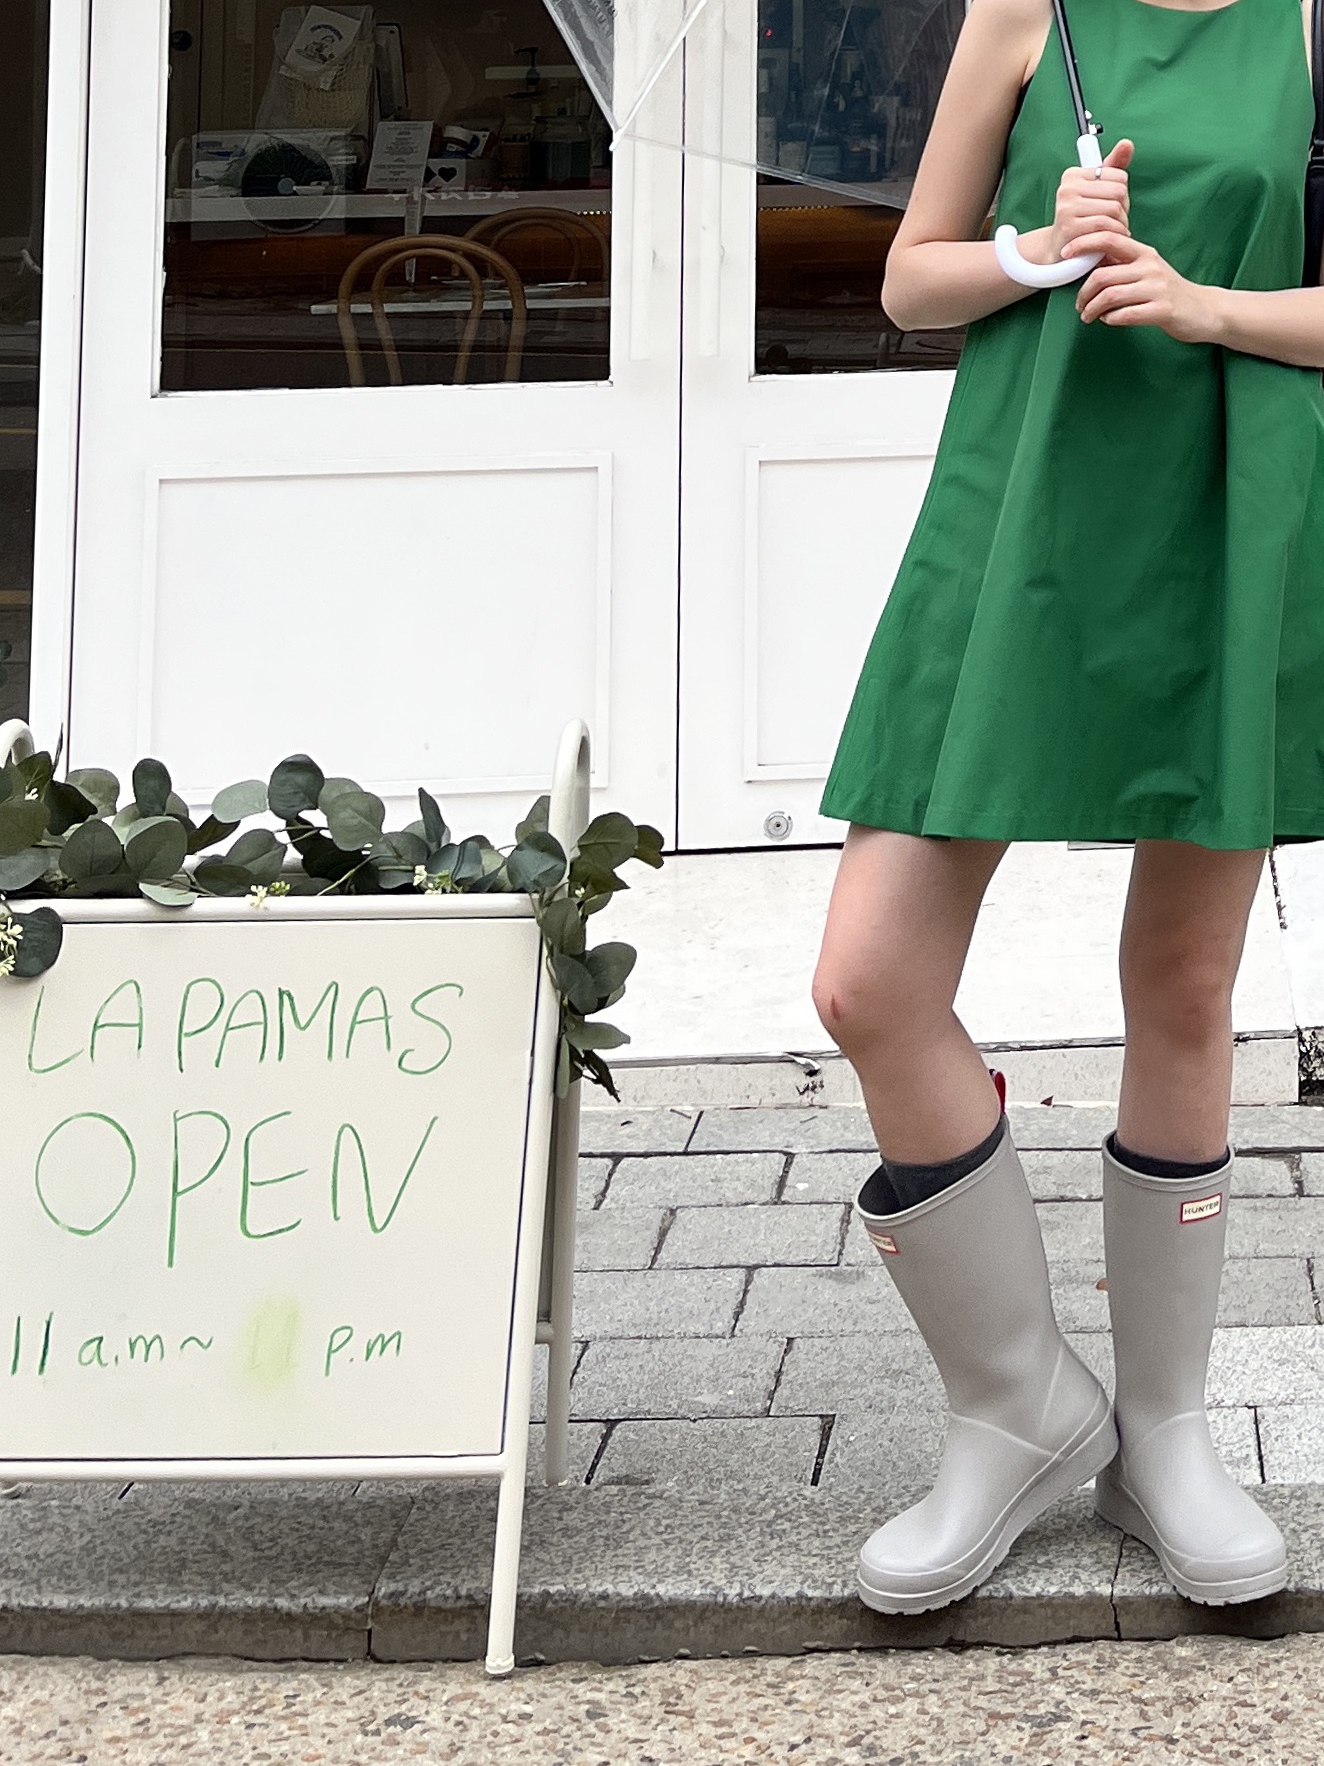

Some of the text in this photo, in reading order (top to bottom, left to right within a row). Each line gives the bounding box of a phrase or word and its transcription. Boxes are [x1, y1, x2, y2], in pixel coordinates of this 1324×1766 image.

[27, 976, 464, 1076] LA PAMAS
[35, 1109, 438, 1268] OPEN
[1184, 1200, 1219, 1215] HUNTER
